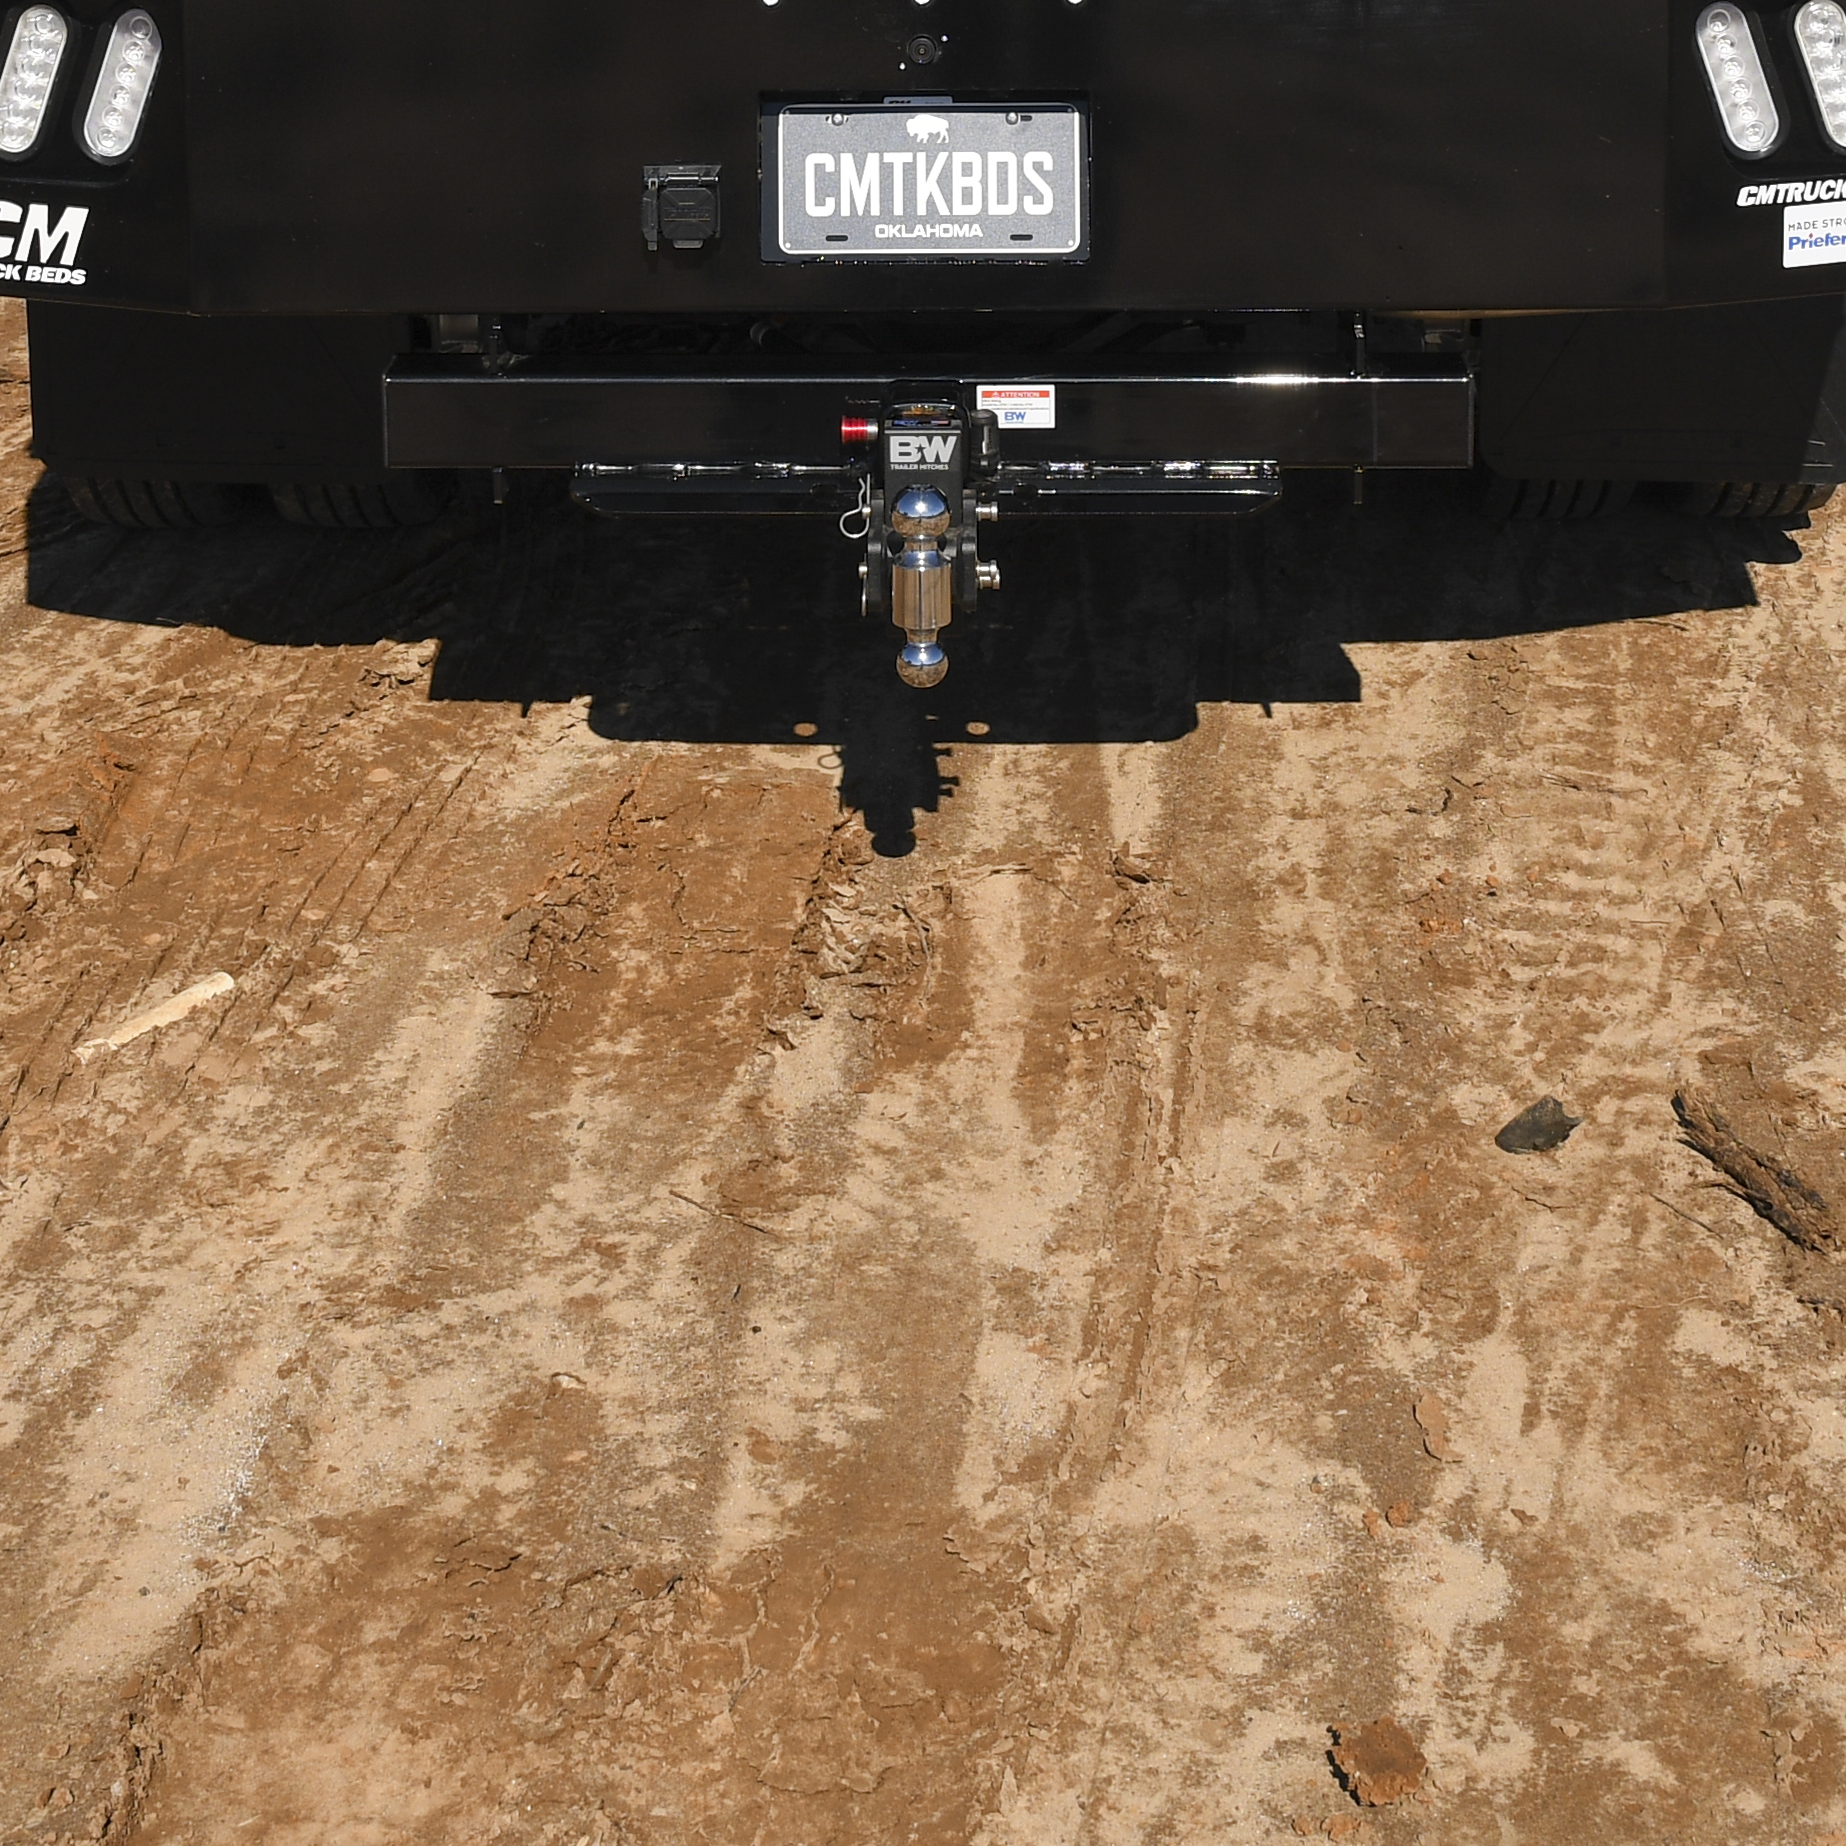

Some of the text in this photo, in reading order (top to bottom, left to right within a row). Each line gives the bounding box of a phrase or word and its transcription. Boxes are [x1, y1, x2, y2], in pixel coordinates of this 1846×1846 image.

[804, 150, 1055, 217] CMTKBDS
[875, 223, 983, 238] OKLAHOMA
[1788, 219, 1819, 232] MADE
[25, 265, 87, 285] BEDS
[919, 463, 949, 471] HITCHES
